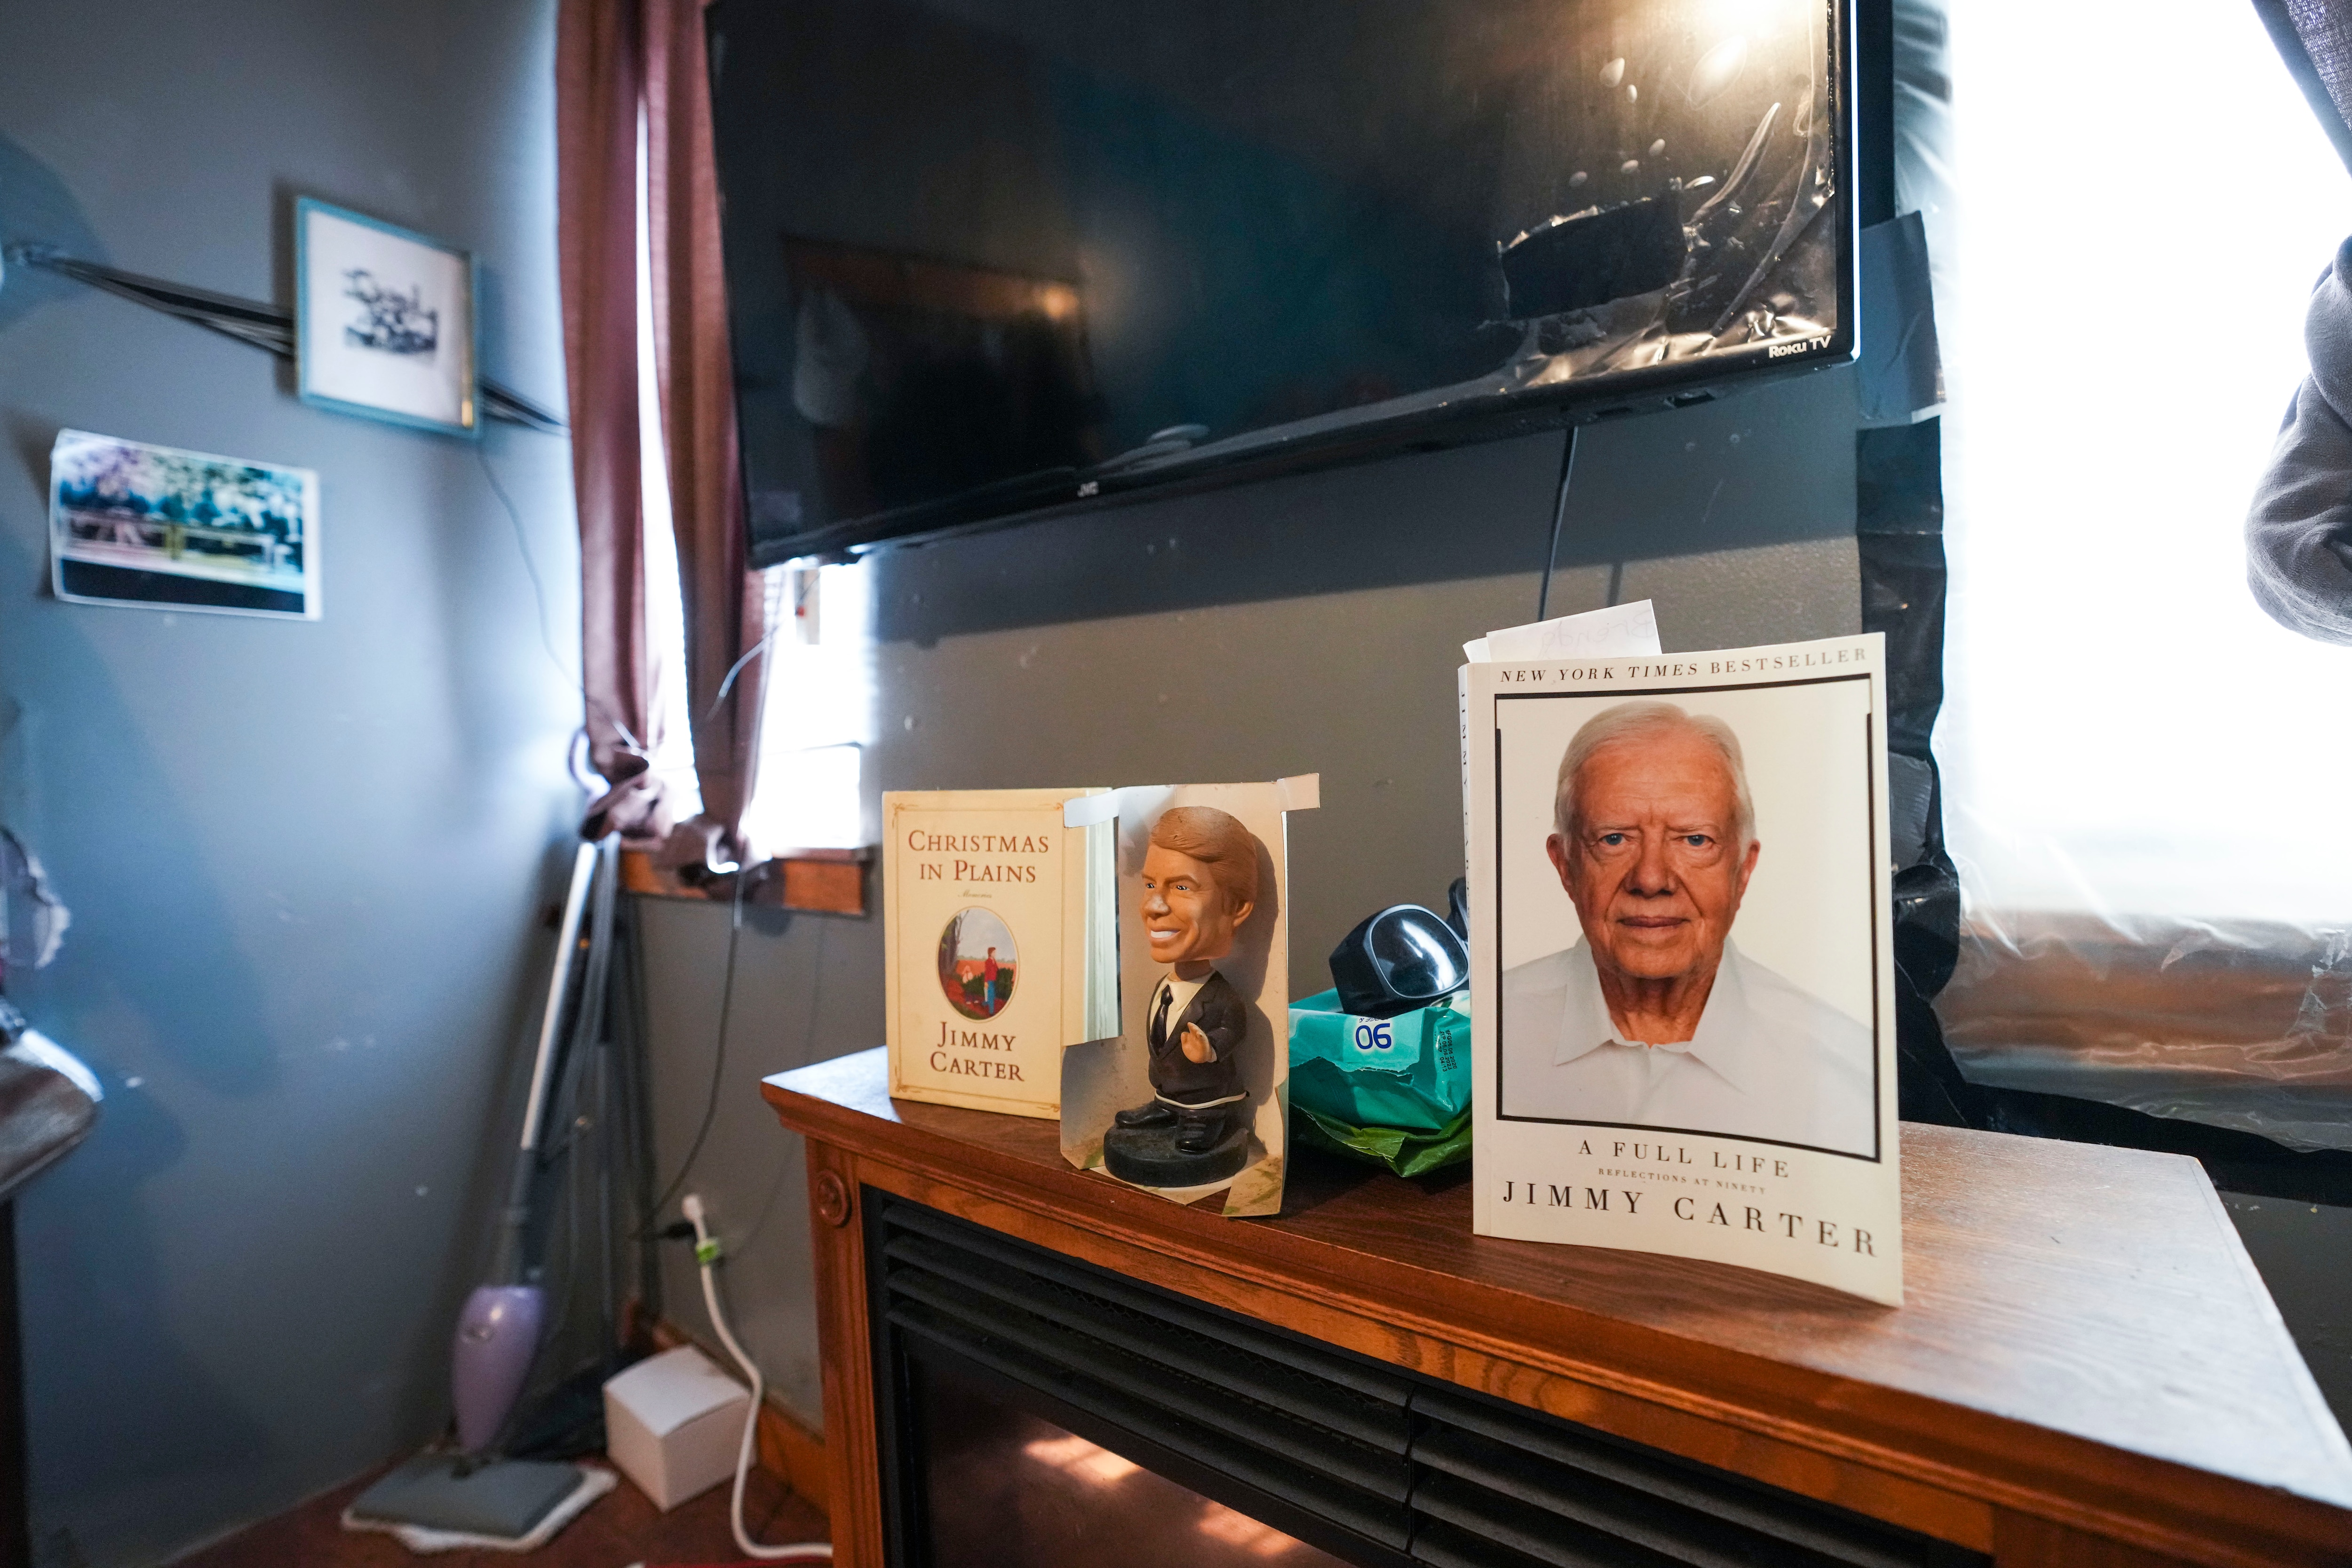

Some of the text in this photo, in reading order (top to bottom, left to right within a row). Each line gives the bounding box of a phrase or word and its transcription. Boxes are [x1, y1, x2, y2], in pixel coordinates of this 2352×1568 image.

[1809, 335, 1831, 350] TV
[1501, 648, 1867, 682] NEW YORK TIMES BESTSELLER
[908, 830, 1049, 853] CHRISTMAS
[920, 860, 1036, 883] IN PLAINS
[938, 1022, 1016, 1051] JIMMY
[930, 1052, 1025, 1082] CARTER
[1578, 1139, 1789, 1178] A FULL LIFE
[1598, 1168, 1687, 1183] REFLECTIONS
[1716, 1181, 1766, 1194] NINETY
[1503, 1181, 1878, 1258] JIMMY CARTER
